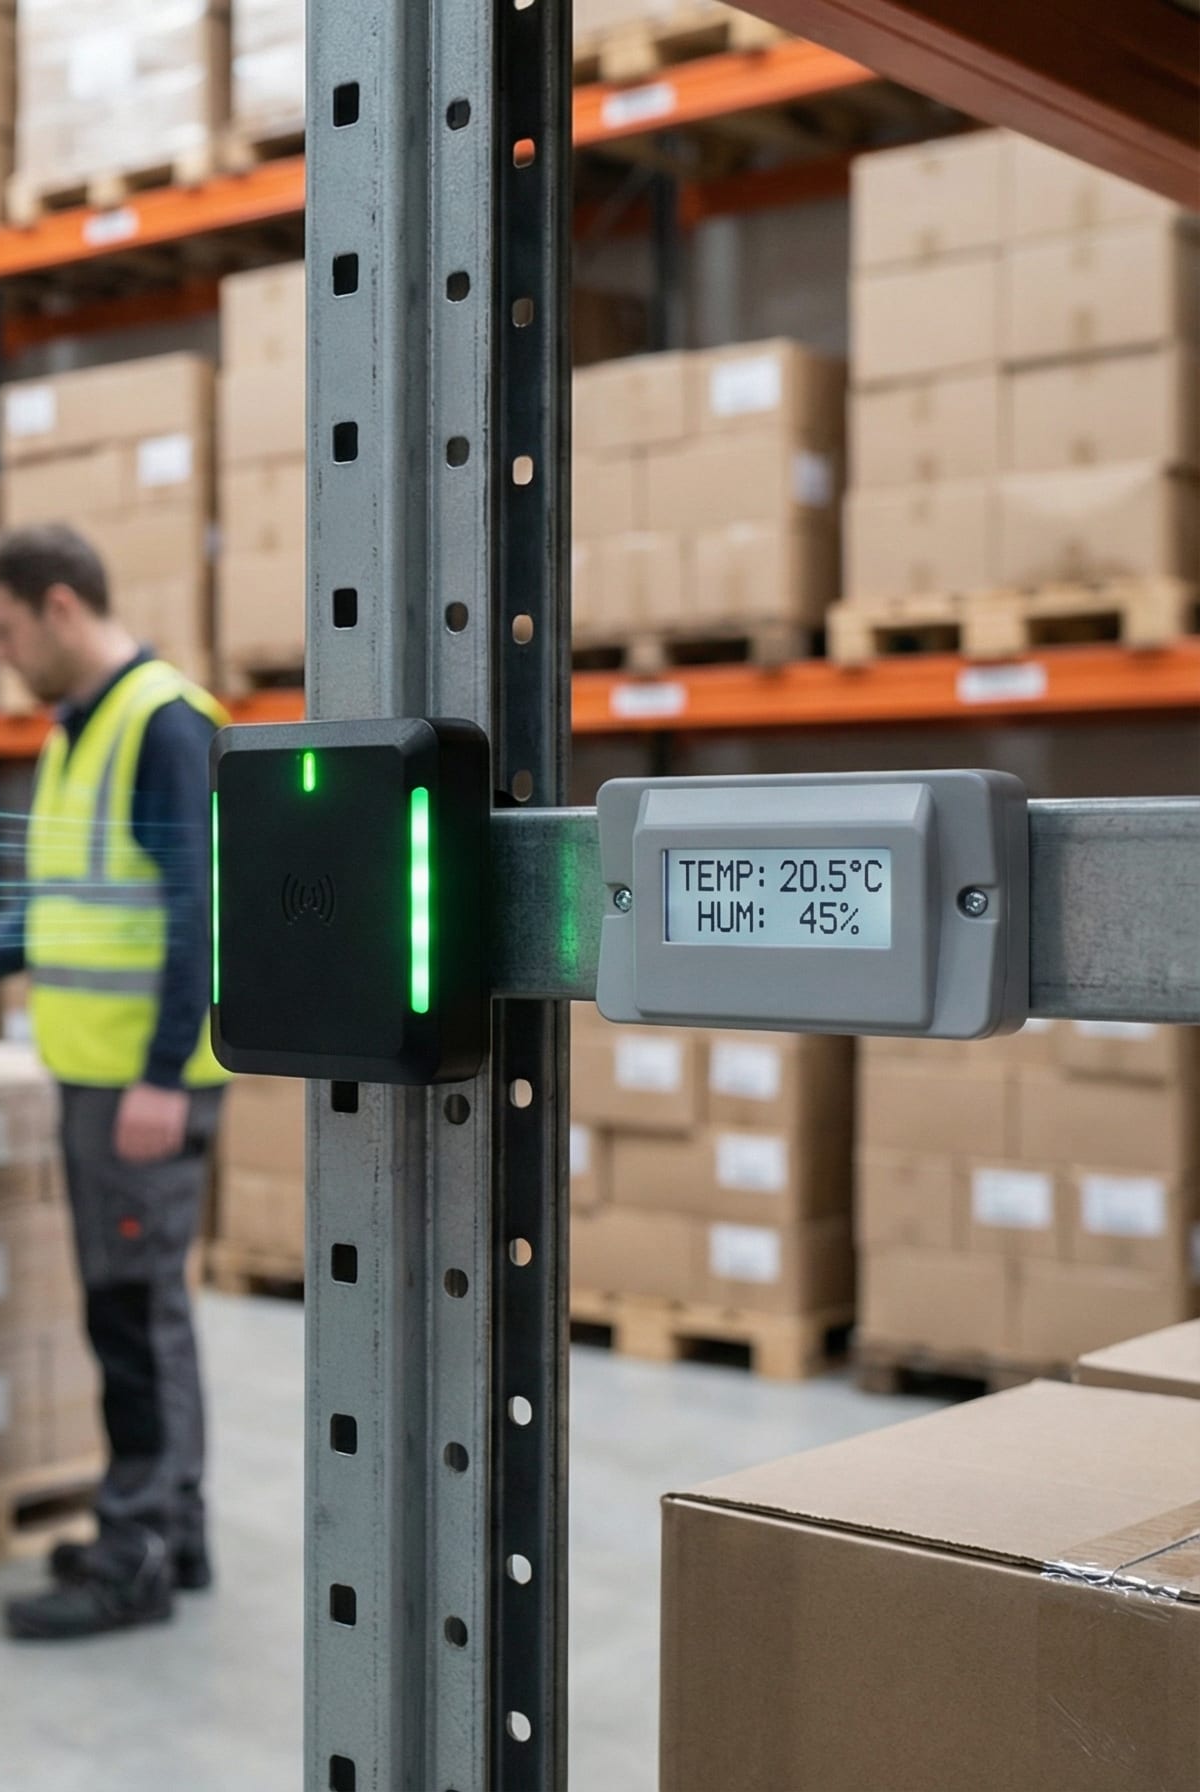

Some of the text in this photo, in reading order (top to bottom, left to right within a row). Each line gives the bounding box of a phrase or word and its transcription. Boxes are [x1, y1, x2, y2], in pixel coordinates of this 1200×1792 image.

[678, 859, 882, 892] TEMP: 20.5°C
[697, 900, 860, 936] HUM: 45%
